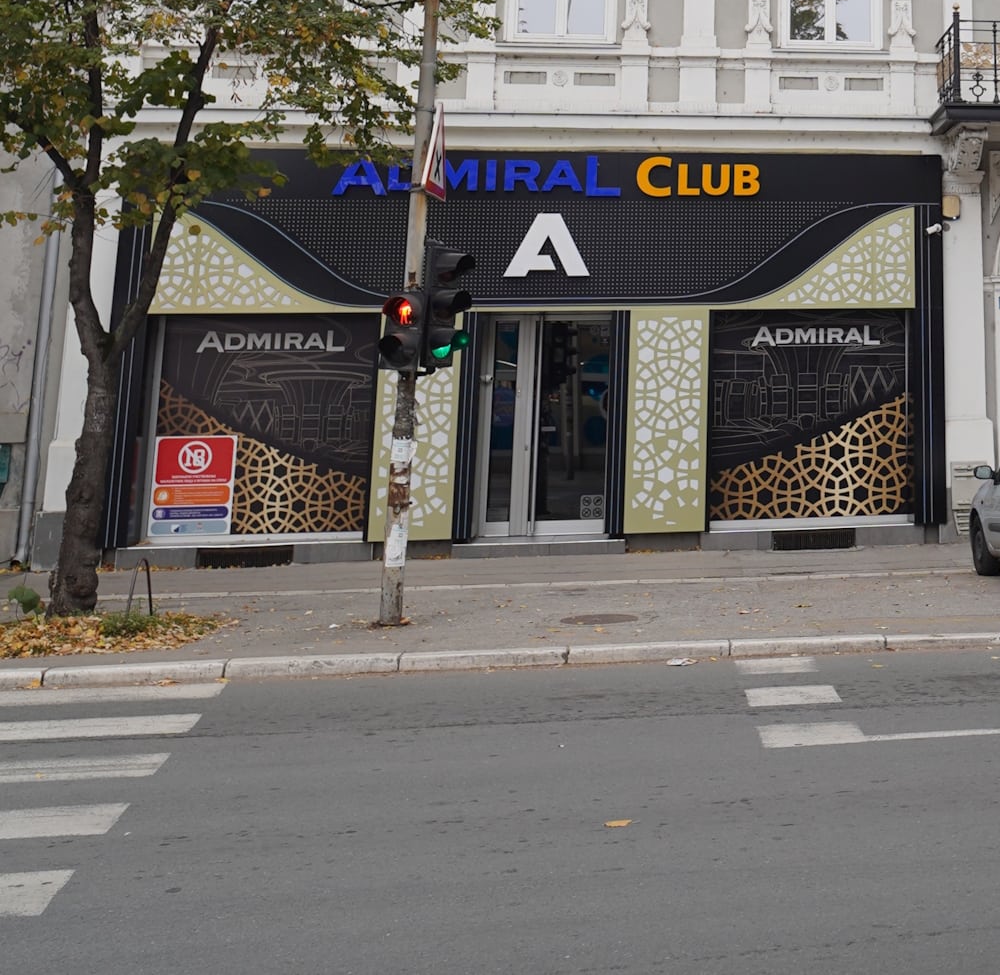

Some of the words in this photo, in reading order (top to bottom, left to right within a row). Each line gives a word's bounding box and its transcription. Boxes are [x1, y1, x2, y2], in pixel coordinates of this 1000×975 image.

[636, 155, 761, 198] CLUB
[196, 330, 346, 353] ADMIRAL
[751, 325, 881, 347] ADMIRAL
